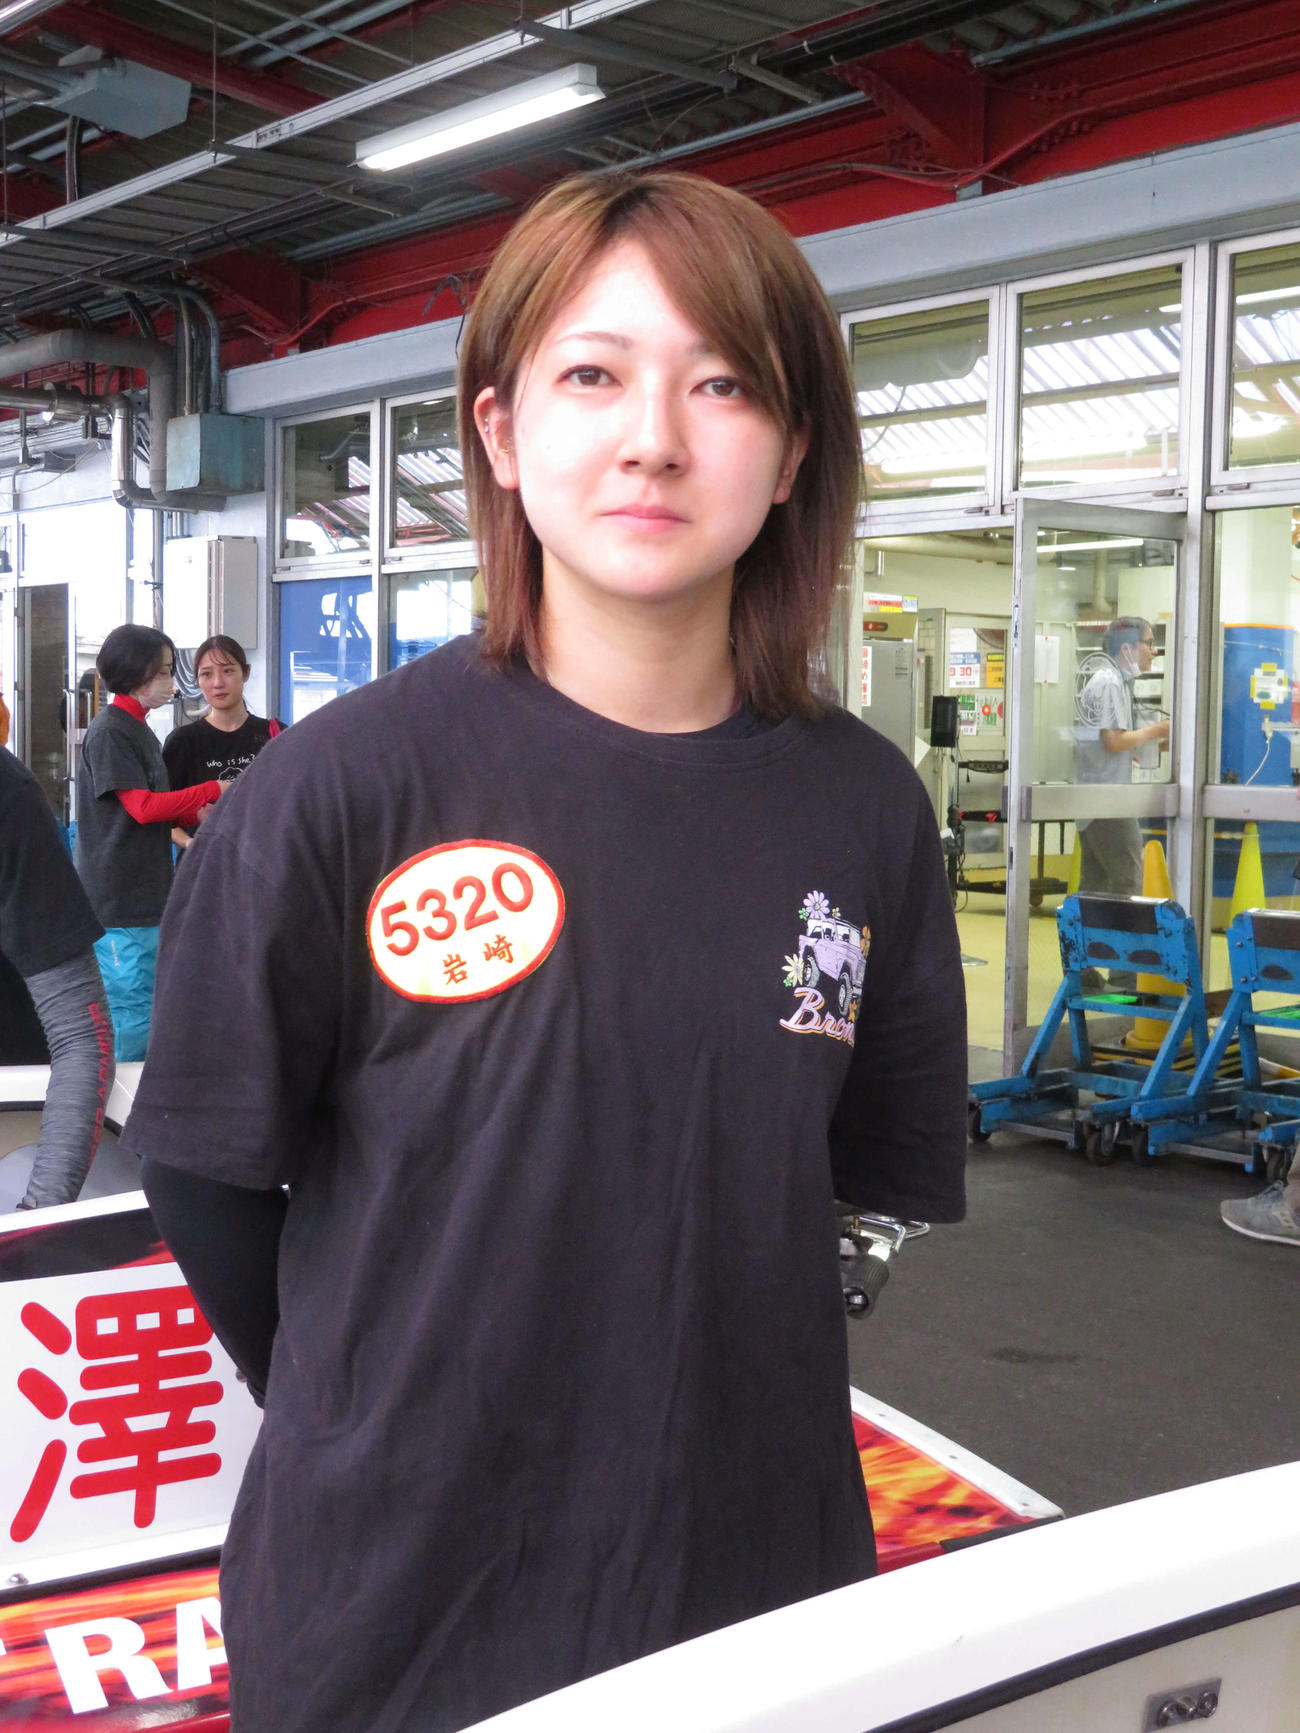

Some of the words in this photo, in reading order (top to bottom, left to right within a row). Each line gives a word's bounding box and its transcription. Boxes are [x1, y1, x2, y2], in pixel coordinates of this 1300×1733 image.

[380, 862, 534, 957] 5320
[442, 934, 514, 985] 岩崎
[10, 1284, 225, 1543] 澤
